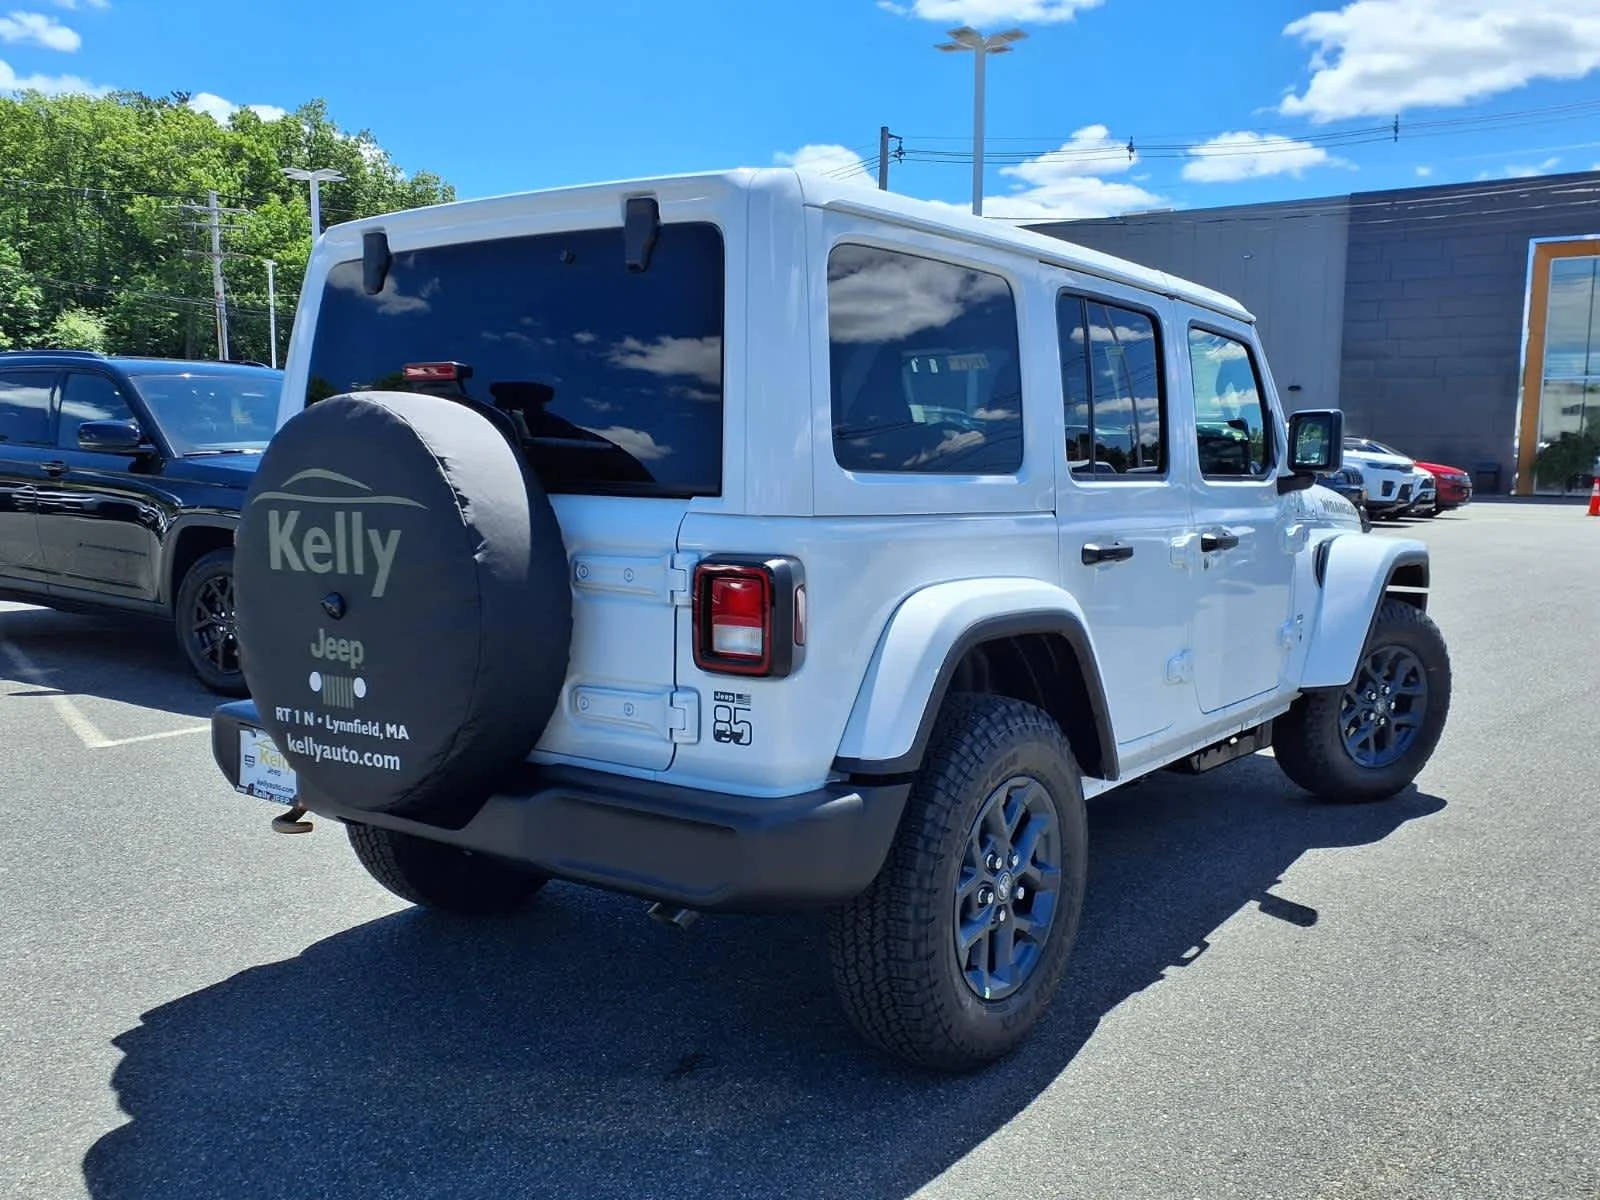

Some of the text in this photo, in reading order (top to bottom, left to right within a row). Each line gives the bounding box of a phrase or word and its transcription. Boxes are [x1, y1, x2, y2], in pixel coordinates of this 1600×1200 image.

[267, 509, 402, 598] Kelly
[310, 628, 364, 669] Jeep
[715, 692, 734, 702] Jeep
[275, 706, 410, 740] RT 1 N Lynnfield, MA
[713, 704, 752, 746] 85
[286, 732, 400, 771] kellyauto.com
